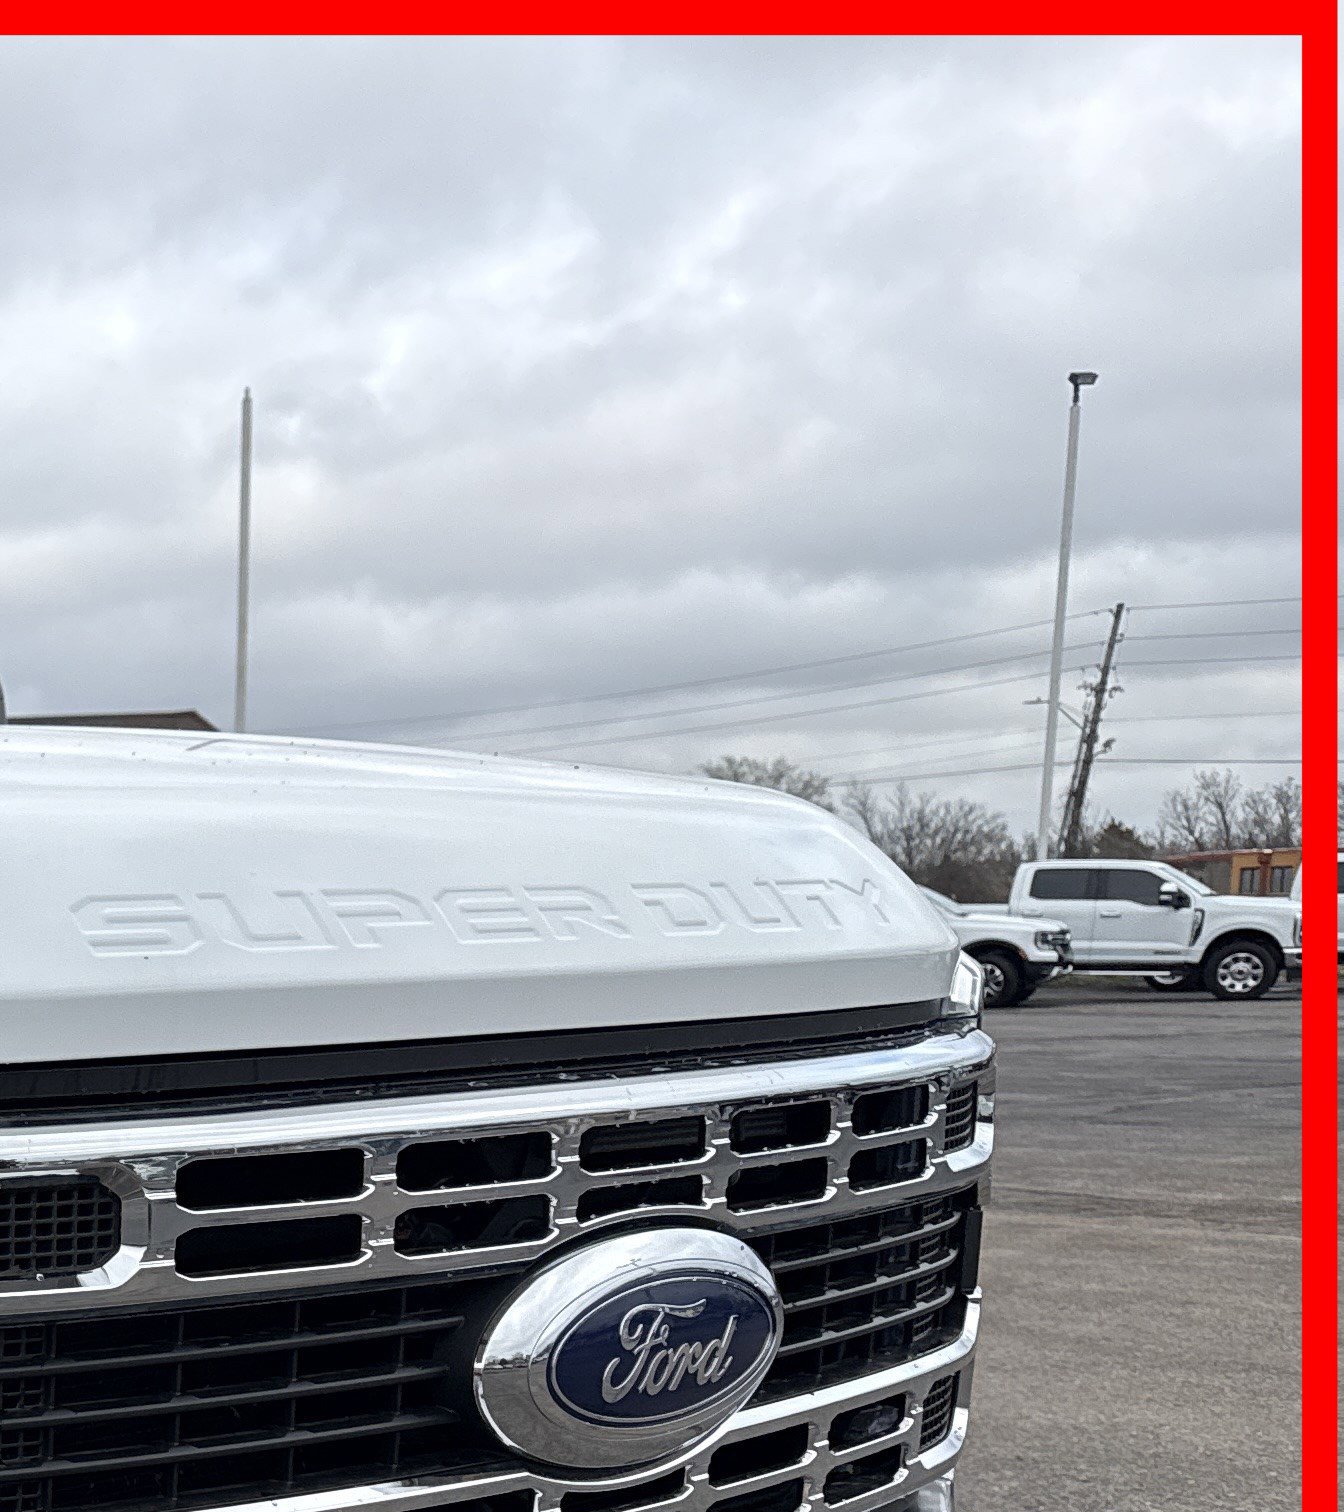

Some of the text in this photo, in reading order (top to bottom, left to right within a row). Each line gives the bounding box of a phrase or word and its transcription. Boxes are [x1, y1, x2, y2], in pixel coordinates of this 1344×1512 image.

[69, 878, 896, 957] SUPER DUTY
[602, 1299, 739, 1403] Ford
